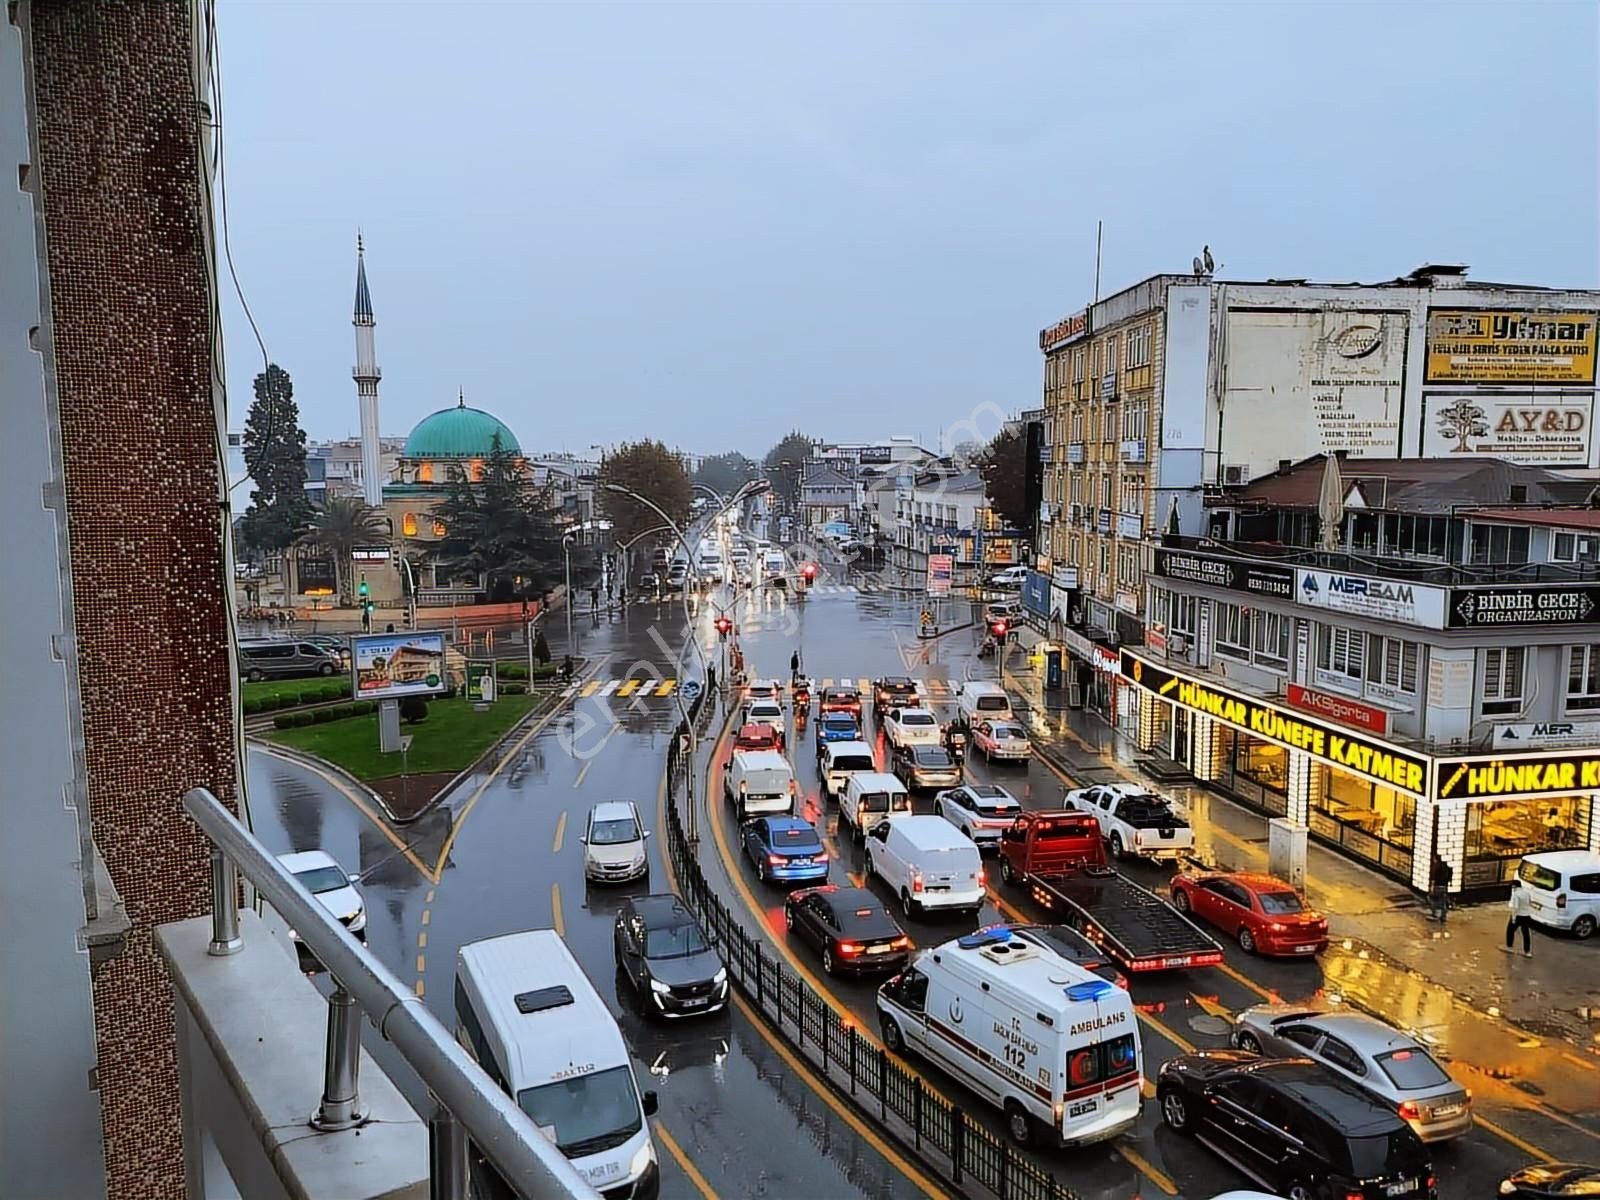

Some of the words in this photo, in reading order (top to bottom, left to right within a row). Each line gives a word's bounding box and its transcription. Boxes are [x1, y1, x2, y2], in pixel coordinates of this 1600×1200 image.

[1495, 407, 1584, 433] AY&D
[1201, 560, 1227, 575] GECE
[1328, 575, 1415, 604] MERSAM
[1477, 590, 1534, 610] BİNBİR
[1537, 593, 1579, 609] GECE
[1178, 681, 1248, 727] HÜNKAR
[1250, 708, 1326, 756] KÜNEFE
[1329, 734, 1423, 793] KATMER
[1467, 760, 1577, 795] HÜNKAR
[1070, 1011, 1127, 1037] AMBULANS
[1004, 1042, 1026, 1071] 112
